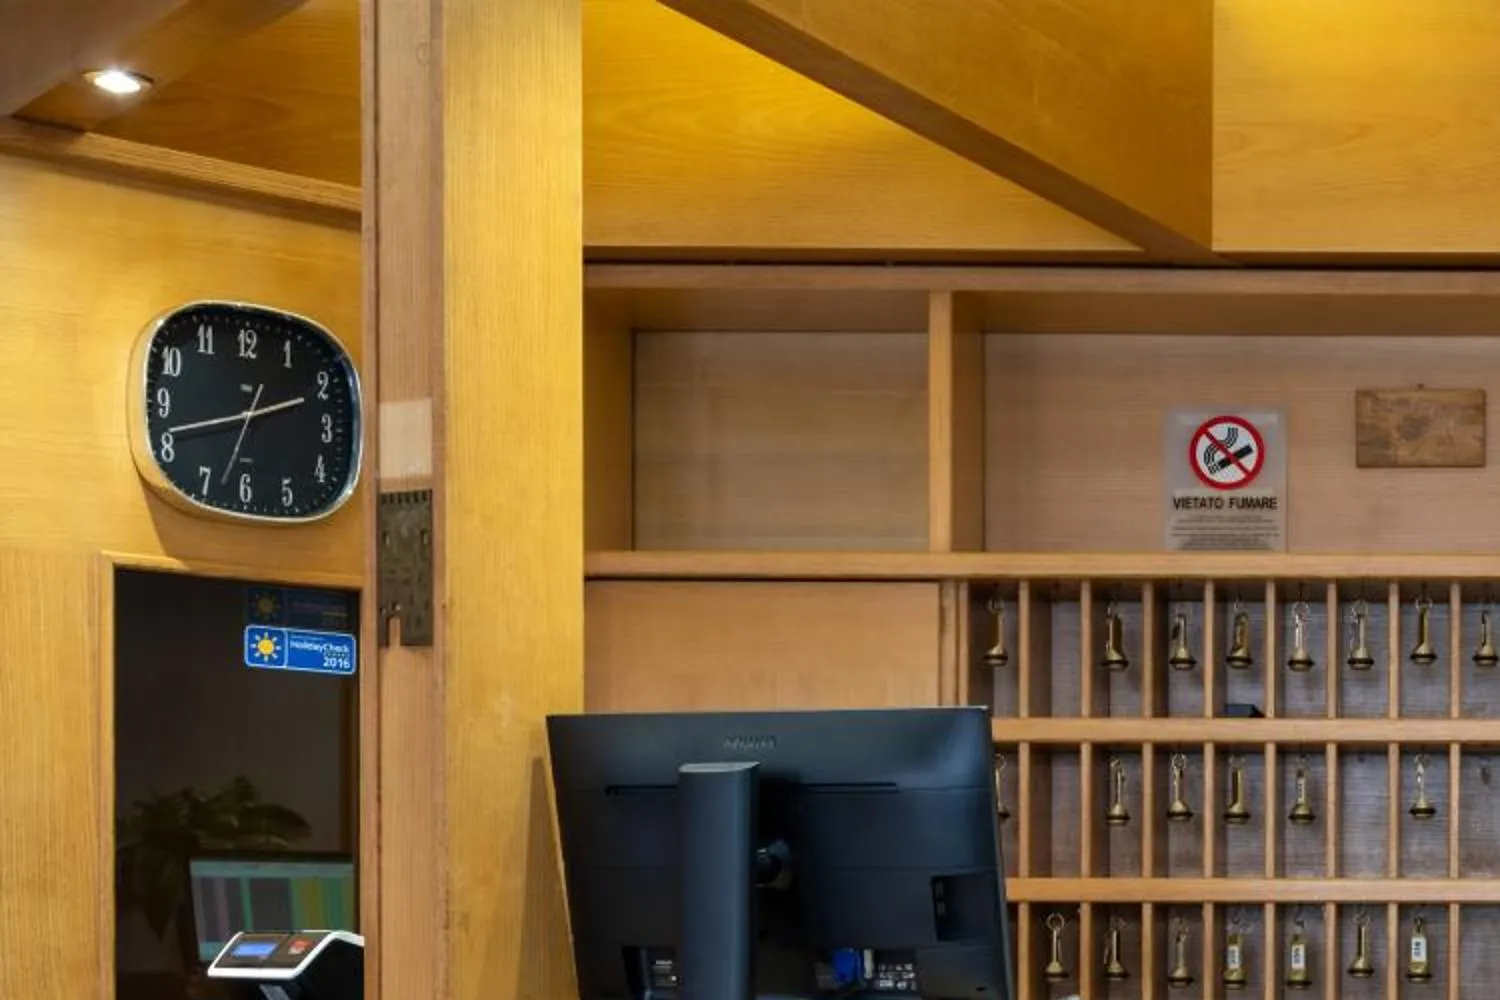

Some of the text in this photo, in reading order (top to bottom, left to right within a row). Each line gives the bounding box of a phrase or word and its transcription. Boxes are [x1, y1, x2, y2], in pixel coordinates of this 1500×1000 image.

[197, 324, 215, 355] 11
[238, 329, 257, 359] 12
[283, 340, 292, 368] 1
[161, 346, 182, 377] 10
[317, 371, 329, 400] 2
[157, 388, 171, 418] 9
[321, 414, 333, 444] 3
[160, 432, 175, 463] 8
[199, 466, 211, 496] 7
[315, 455, 326, 483] 4
[239, 473, 252, 503] 6
[281, 477, 293, 507] 5
[1173, 496, 1278, 510] VIETATO FUMARE
